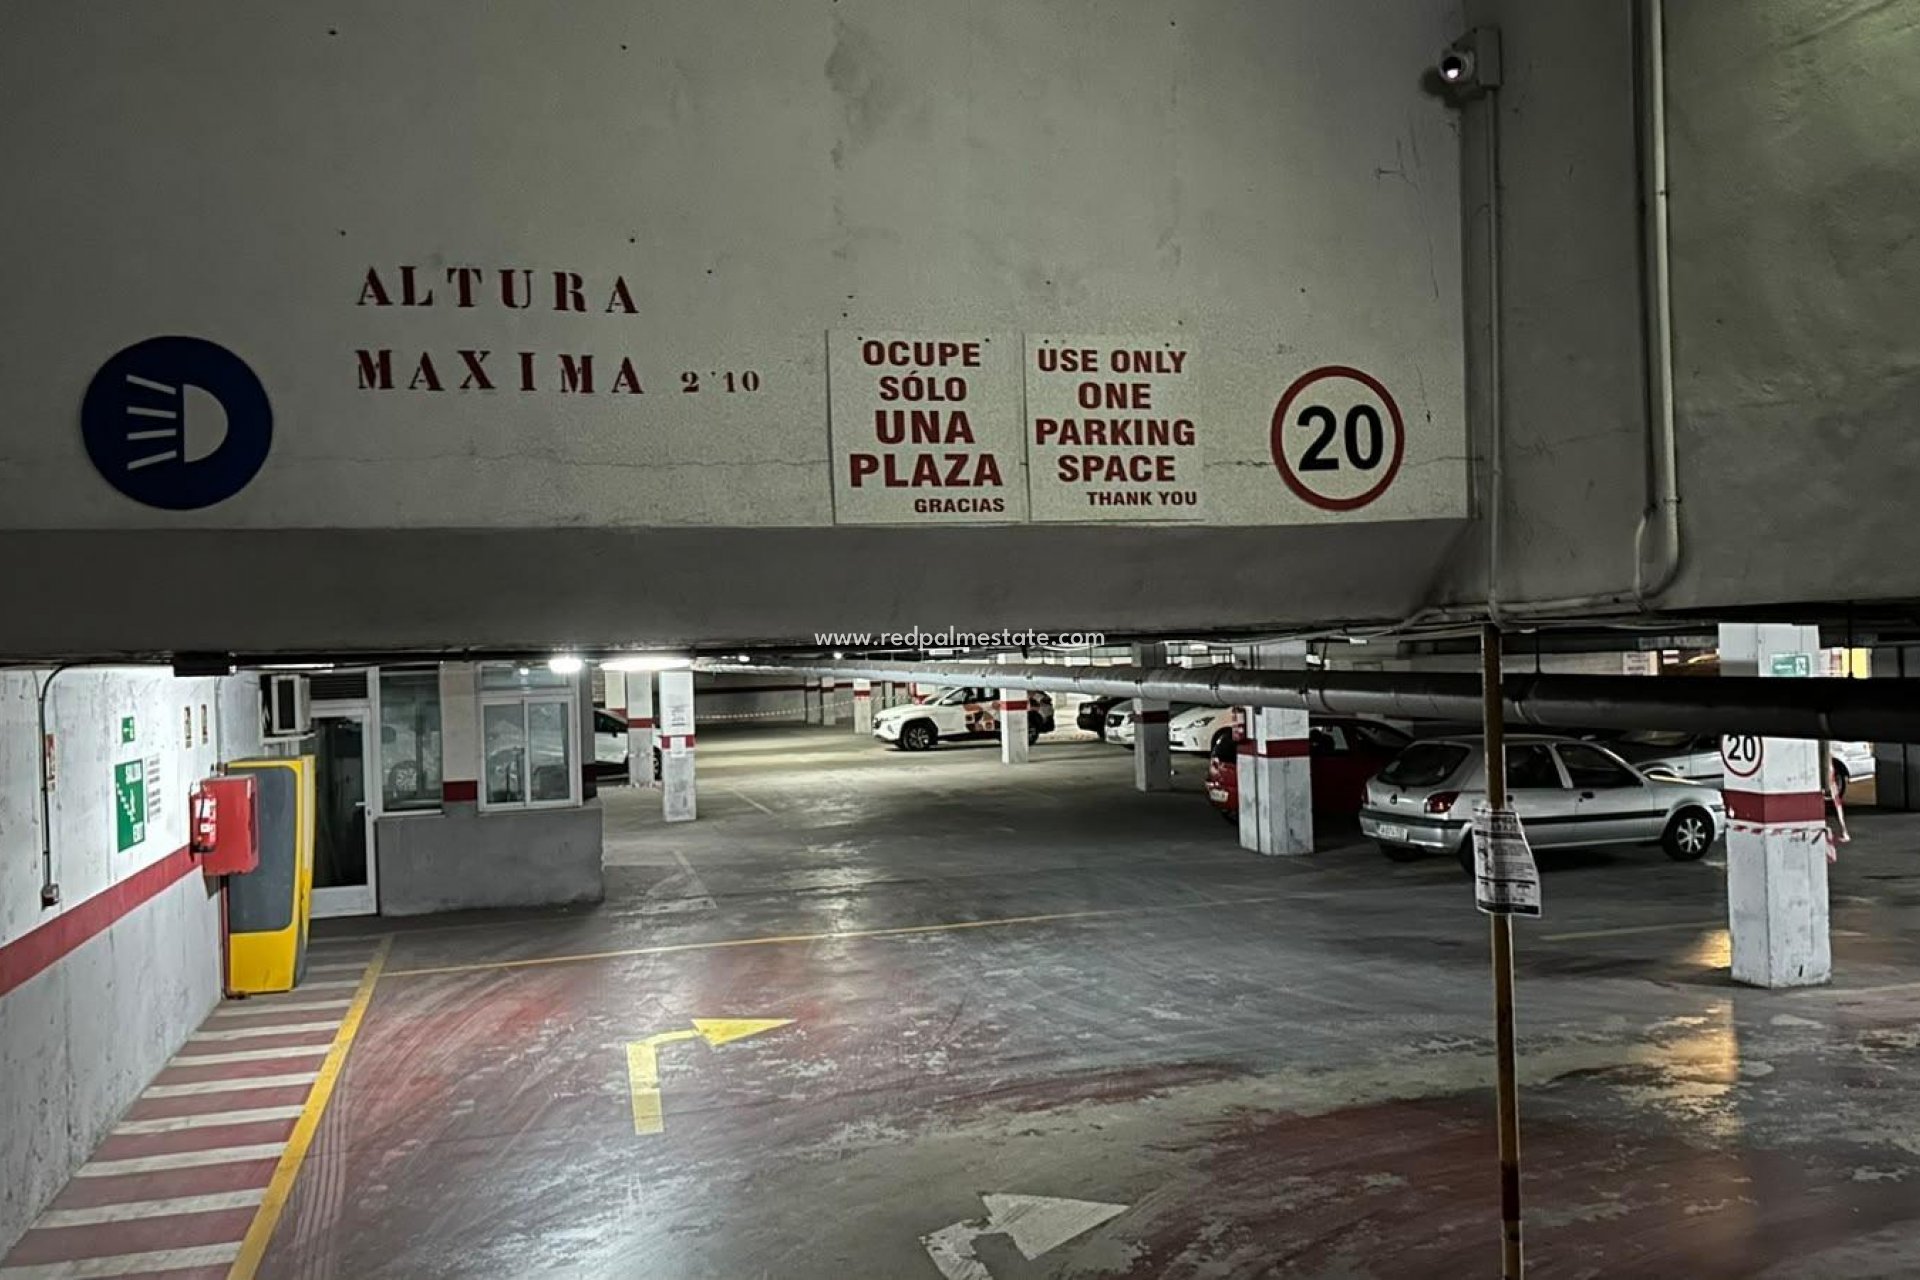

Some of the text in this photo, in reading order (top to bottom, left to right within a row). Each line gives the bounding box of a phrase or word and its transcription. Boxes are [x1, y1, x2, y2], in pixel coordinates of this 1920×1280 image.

[356, 265, 640, 314] ALTURA
[862, 340, 981, 368] OCUPE
[1037, 348, 1187, 374] USE ONLY
[355, 349, 644, 394] MAXIMA
[879, 370, 967, 402] SÓLO
[1078, 382, 1151, 409] ONE
[875, 410, 975, 445] UNA
[1035, 418, 1195, 446] PARKING
[1297, 404, 1384, 472] 20
[850, 453, 1003, 488] PLAZA
[1058, 454, 1176, 482] SPACE
[914, 498, 1005, 513] GRACIAS
[1087, 491, 1198, 506] THANK YOU
[1727, 734, 1756, 762] 20
